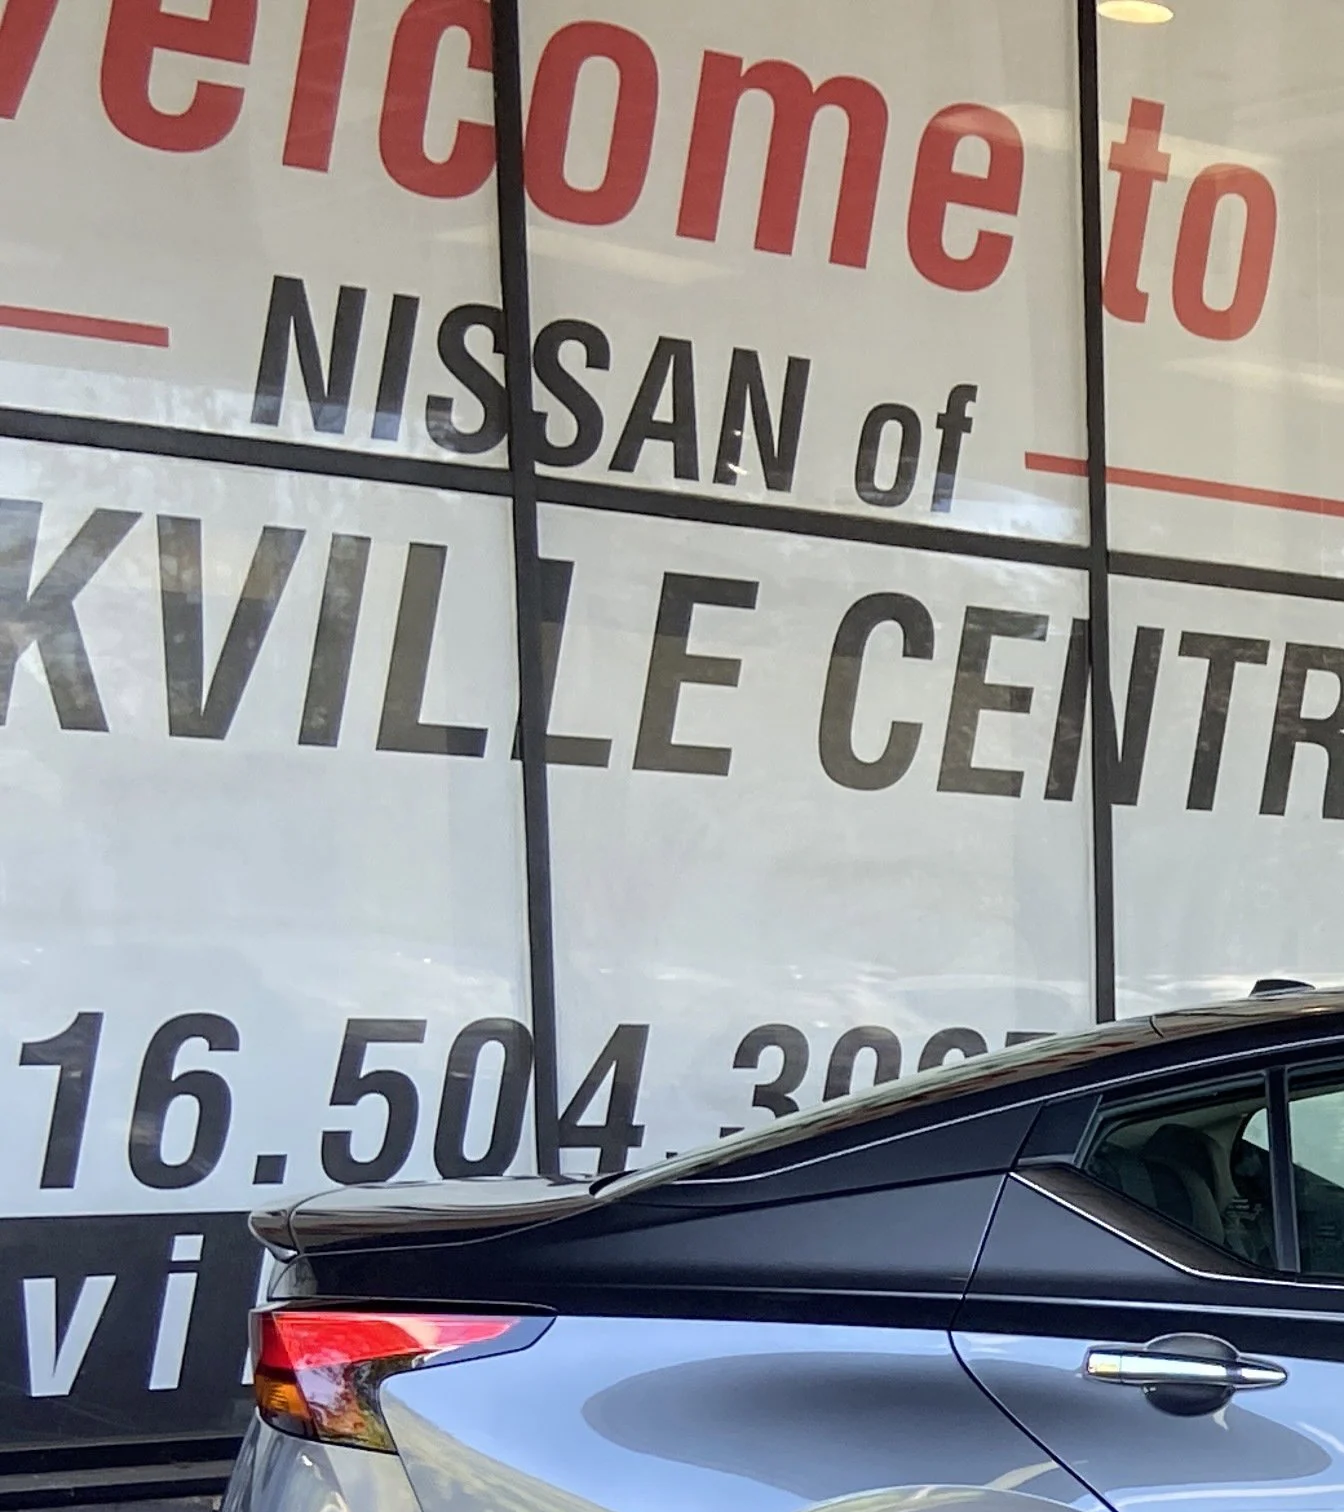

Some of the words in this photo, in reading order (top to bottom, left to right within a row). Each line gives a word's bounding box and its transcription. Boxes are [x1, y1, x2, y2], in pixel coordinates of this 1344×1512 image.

[0, 0, 1025, 292] elcome
[1101, 97, 1277, 342] to
[250, 274, 812, 492] NISSAN
[854, 384, 978, 514] of
